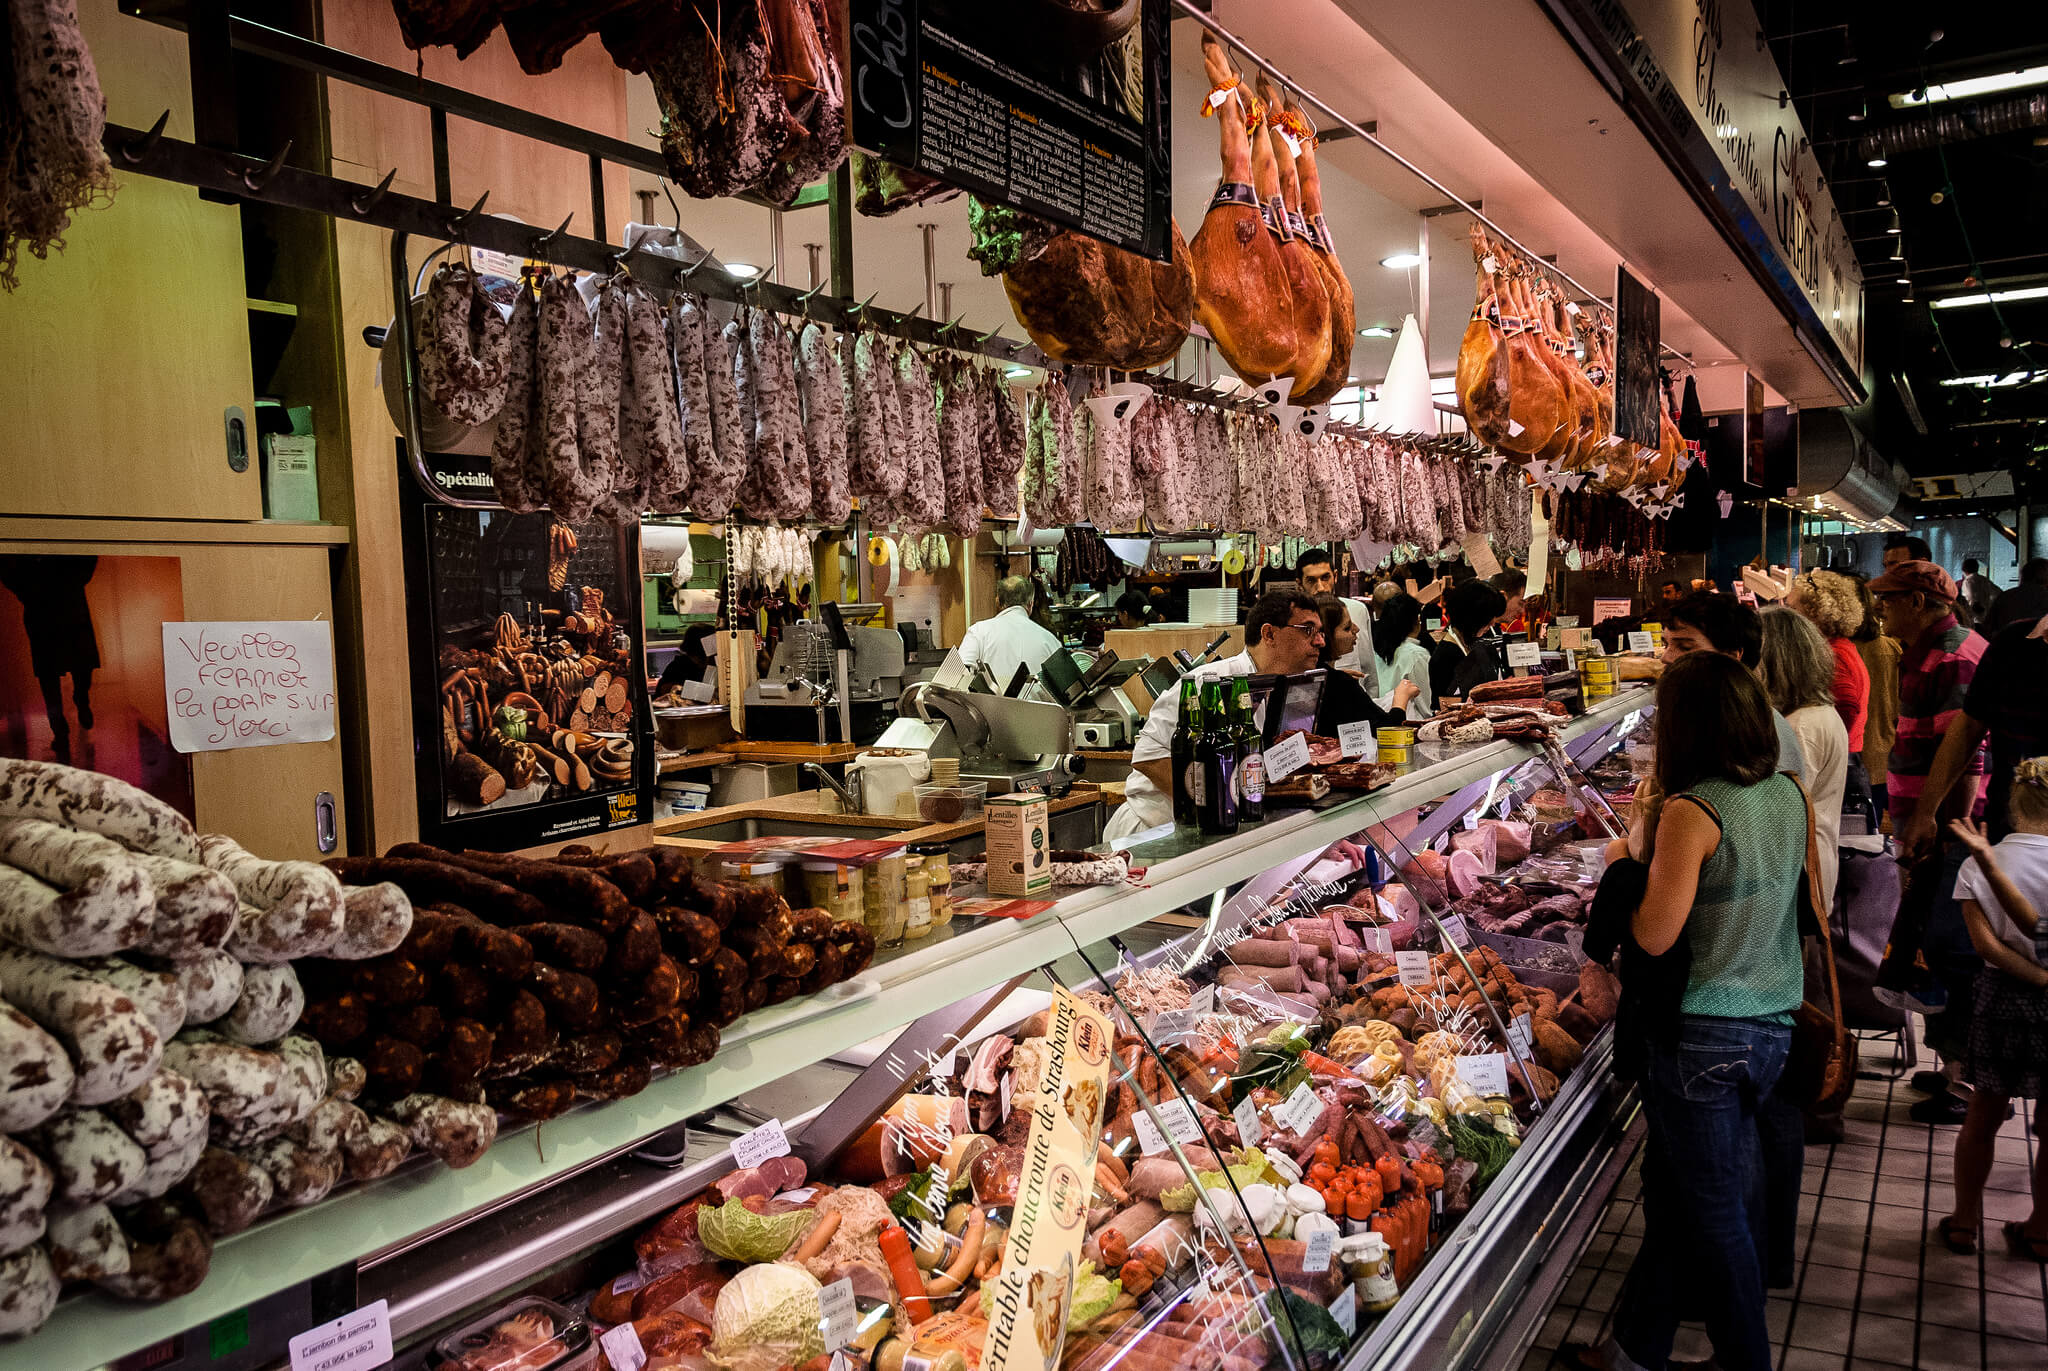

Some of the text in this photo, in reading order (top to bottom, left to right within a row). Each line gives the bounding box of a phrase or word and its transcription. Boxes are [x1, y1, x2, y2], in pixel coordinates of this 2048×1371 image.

[922, 61, 930, 73] La
[1637, 55, 1661, 94] DES
[1773, 126, 1820, 304] GARCIA
[174, 688, 206, 718] la
[208, 714, 292, 744] Merci
[616, 792, 637, 809] Klein
[1077, 1020, 1094, 1054] Klein
[907, 1162, 950, 1221] bonne
[1053, 1171, 1071, 1214] Klein
[985, 1268, 1024, 1371] éritable
[1010, 1132, 1052, 1267] choucroute
[1039, 1106, 1056, 1132] de
[309, 1322, 370, 1356] jambon de parme
